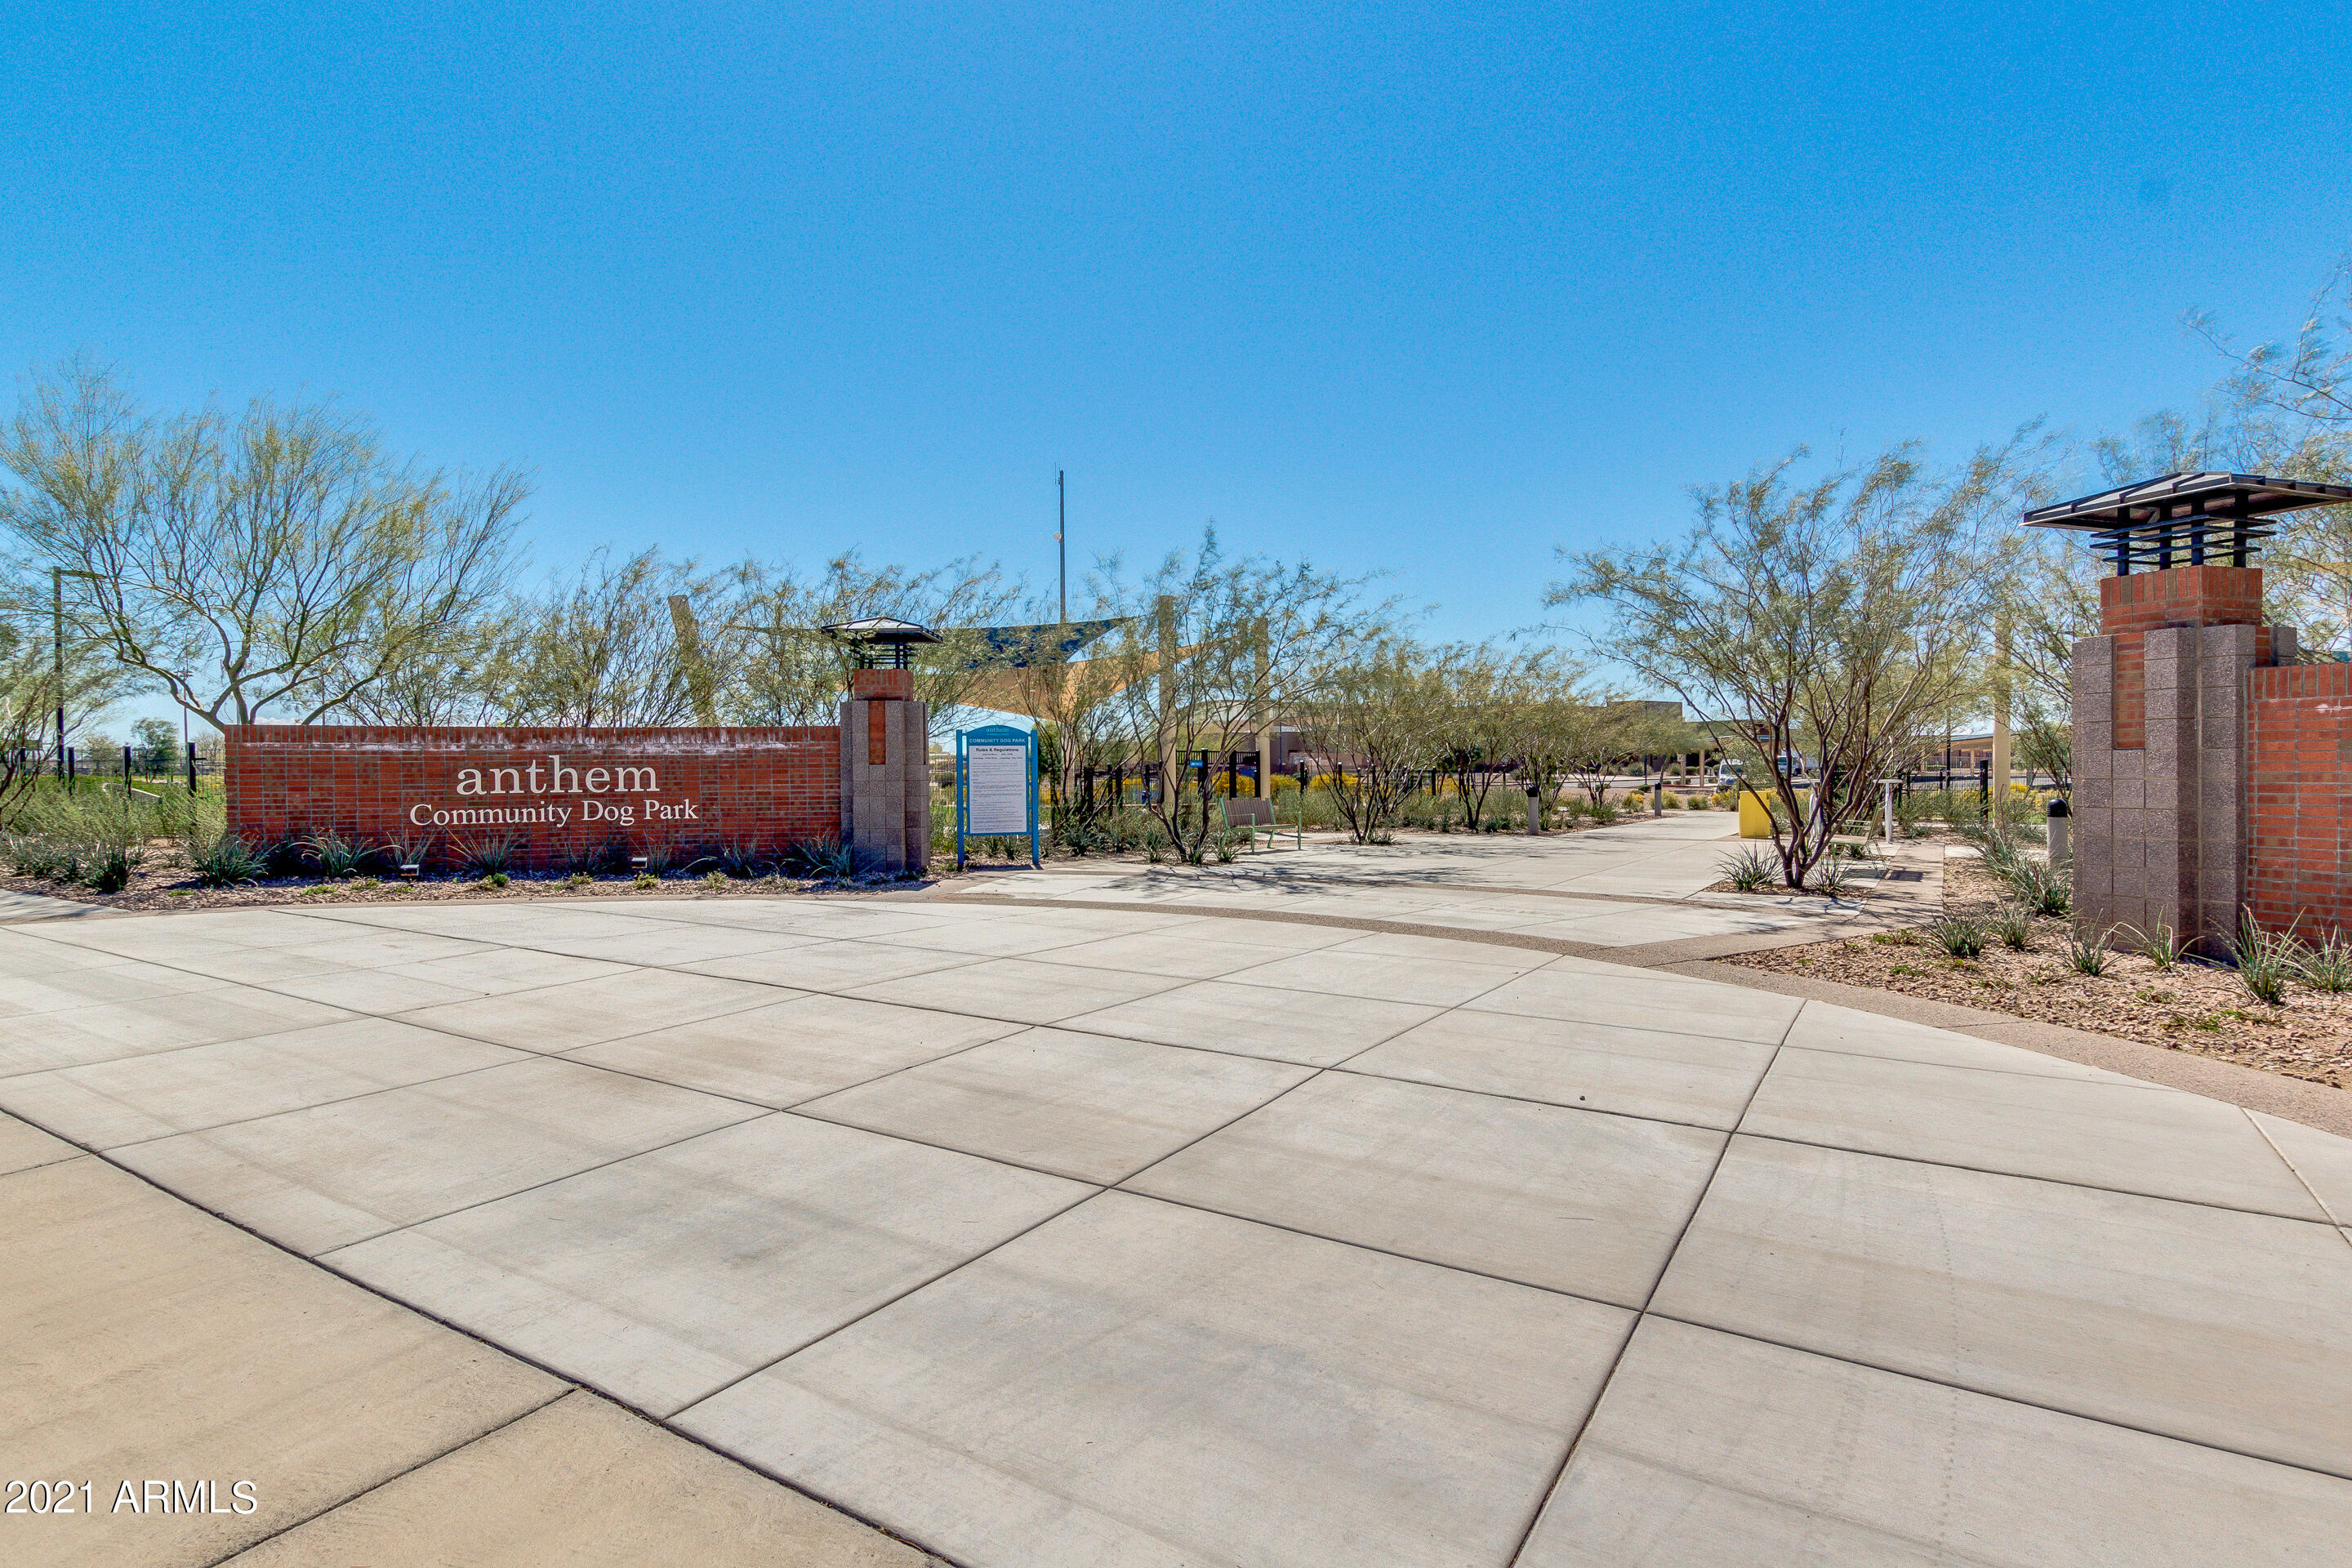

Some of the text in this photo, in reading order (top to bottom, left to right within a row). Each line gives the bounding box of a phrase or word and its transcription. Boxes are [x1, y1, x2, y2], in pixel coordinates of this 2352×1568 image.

[456, 755, 660, 795] anthem
[409, 799, 699, 827] Community Dog Park
